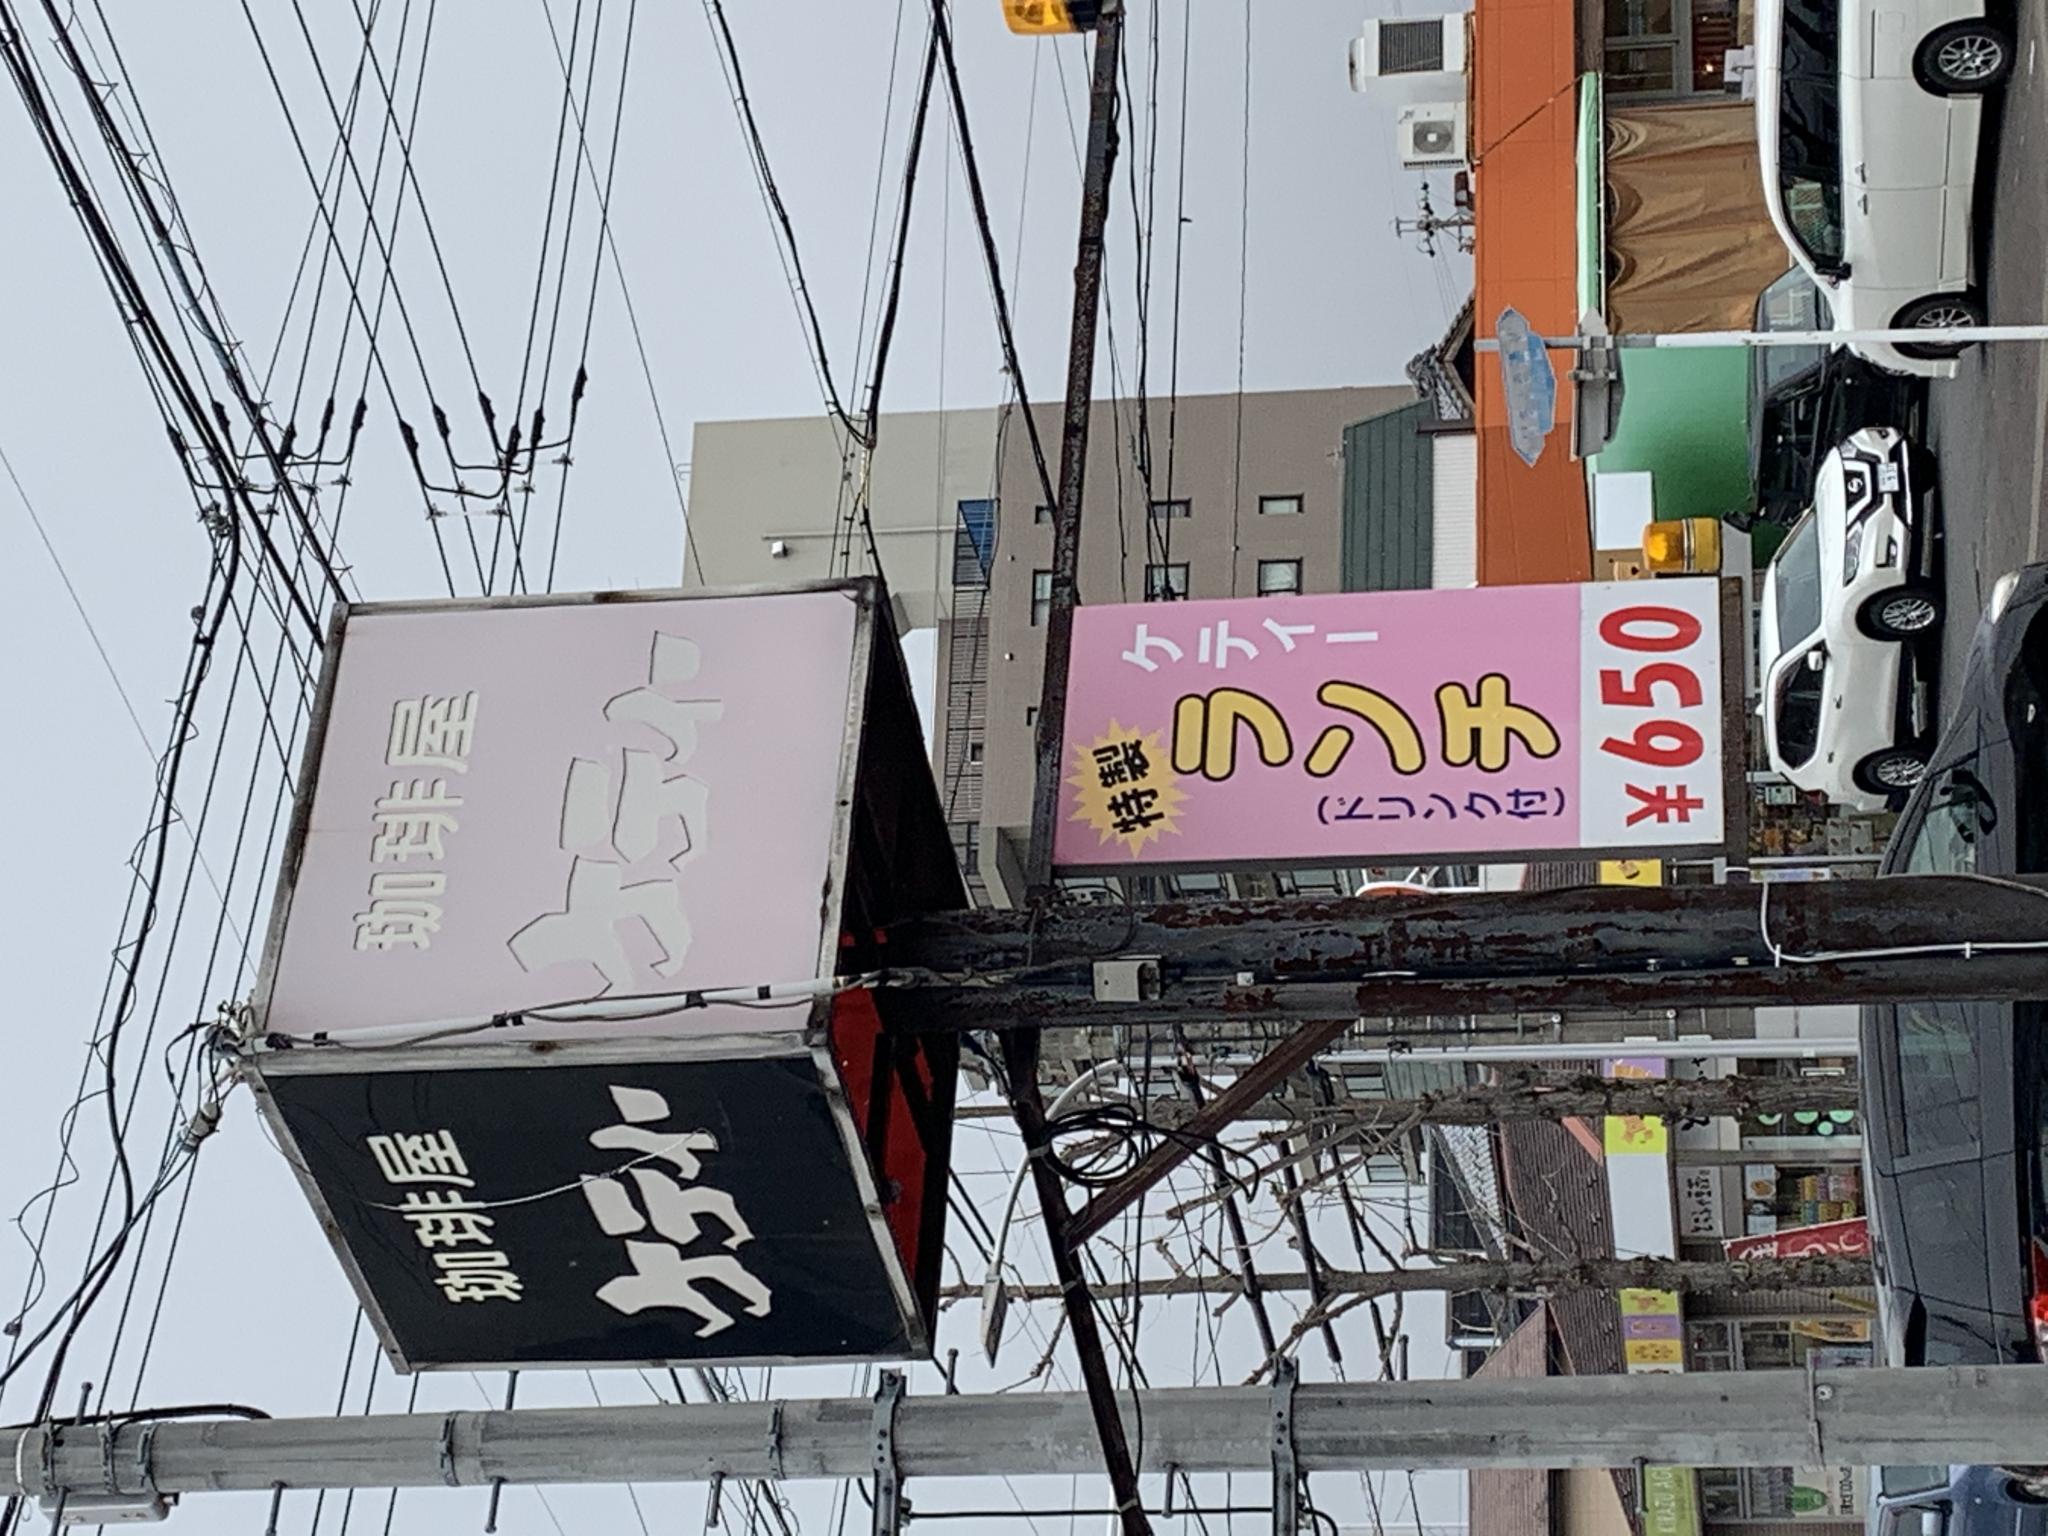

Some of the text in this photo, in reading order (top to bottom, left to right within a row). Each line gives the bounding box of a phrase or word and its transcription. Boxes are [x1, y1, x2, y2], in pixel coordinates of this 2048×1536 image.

[1122, 618, 1379, 672] ケティー
[1092, 739, 1165, 833] 特製
[1171, 672, 1561, 781] ランチ
[1599, 606, 1704, 827] ¥650
[353, 689, 480, 952] 珈琲屋
[367, 1128, 524, 1304] 珈琲屋
